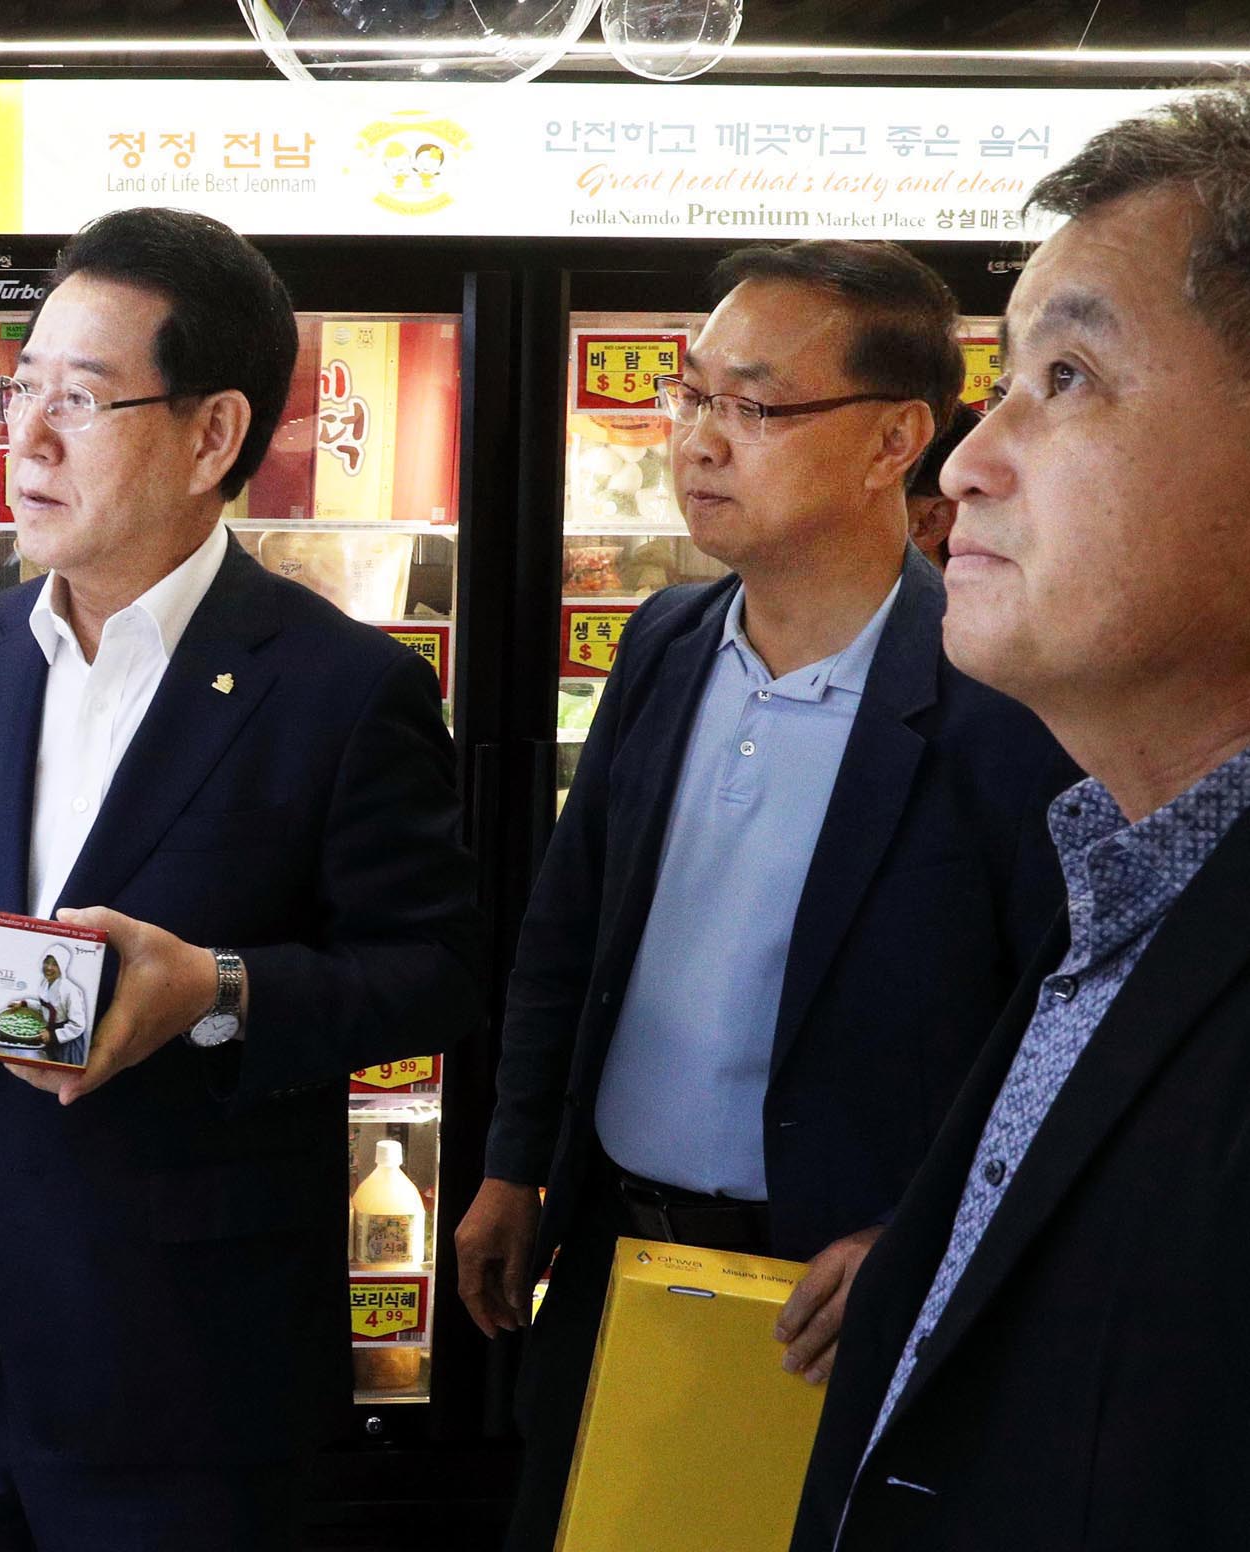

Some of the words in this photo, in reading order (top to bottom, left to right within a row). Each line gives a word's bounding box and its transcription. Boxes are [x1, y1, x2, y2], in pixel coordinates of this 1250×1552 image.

[108, 131, 197, 169] 청정
[223, 131, 317, 169] 전남
[545, 121, 697, 154] 안전하고
[715, 123, 867, 157] 깨끗하고
[886, 126, 960, 157] 좋은
[978, 126, 1051, 160] 음식
[107, 173, 147, 193] Land
[151, 173, 170, 193] of
[172, 172, 201, 193] Life
[205, 173, 239, 193] Best
[243, 174, 317, 194] Jeonnam
[576, 163, 664, 198] Great
[823, 169, 887, 202] tasty
[897, 170, 951, 194] and
[956, 171, 1025, 194] clean
[569, 208, 681, 227] JeollaNamdo
[687, 203, 810, 227] Premium
[816, 210, 877, 228] Market
[882, 211, 926, 228] Place
[351, 1292, 416, 1308] 보리식혜
[365, 1311, 403, 1327] 4.99
